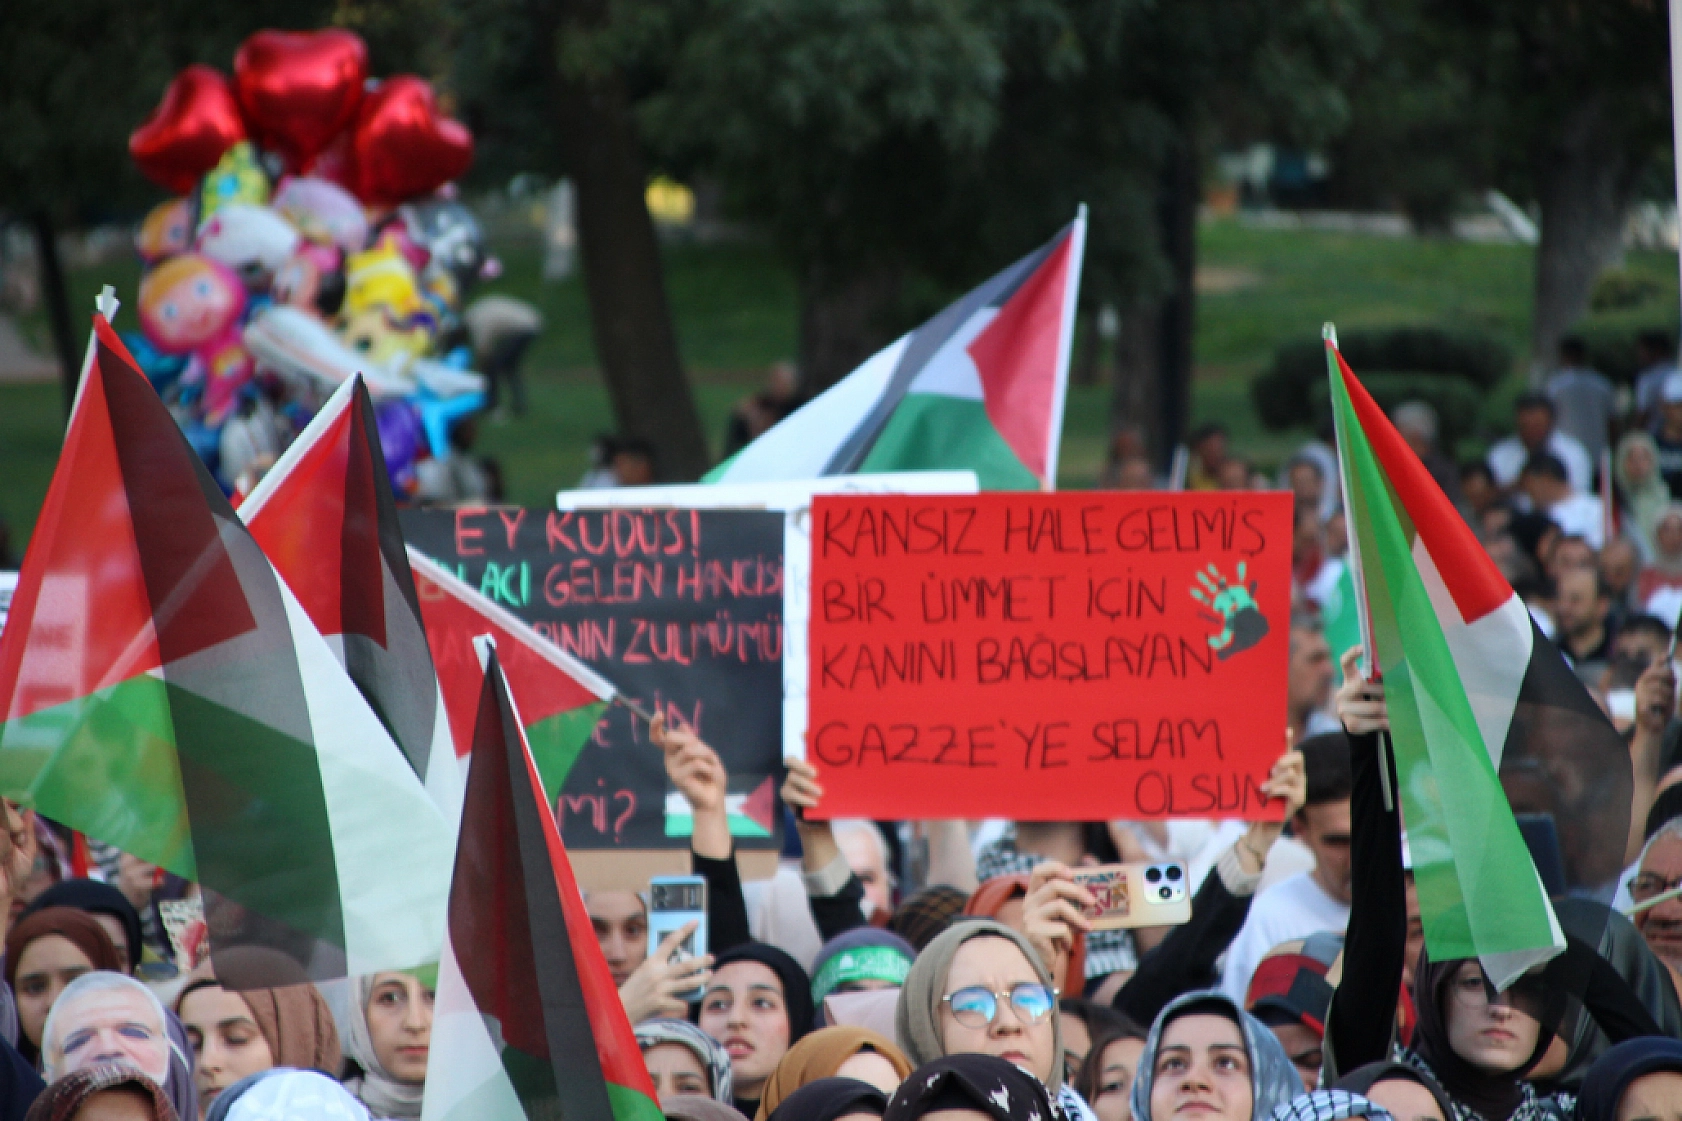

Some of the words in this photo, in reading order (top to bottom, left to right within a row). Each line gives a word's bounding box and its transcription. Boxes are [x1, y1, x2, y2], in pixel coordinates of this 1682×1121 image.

[455, 506, 527, 556] EY
[822, 506, 983, 558] KANSIZ
[1004, 506, 1108, 555] HALE
[1115, 500, 1266, 558] GELMİŞ
[543, 559, 665, 608] GELEN
[822, 572, 895, 623] BİR
[921, 571, 1066, 624] ÜMMET
[1086, 567, 1167, 622] İÇİN
[822, 638, 956, 690] KANINI
[976, 632, 1213, 685] BAĞIŞLAYAN
[814, 720, 1071, 770] GAZZE'YE
[1087, 718, 1224, 761] SELAM
[1134, 768, 1271, 815] OLSUN
